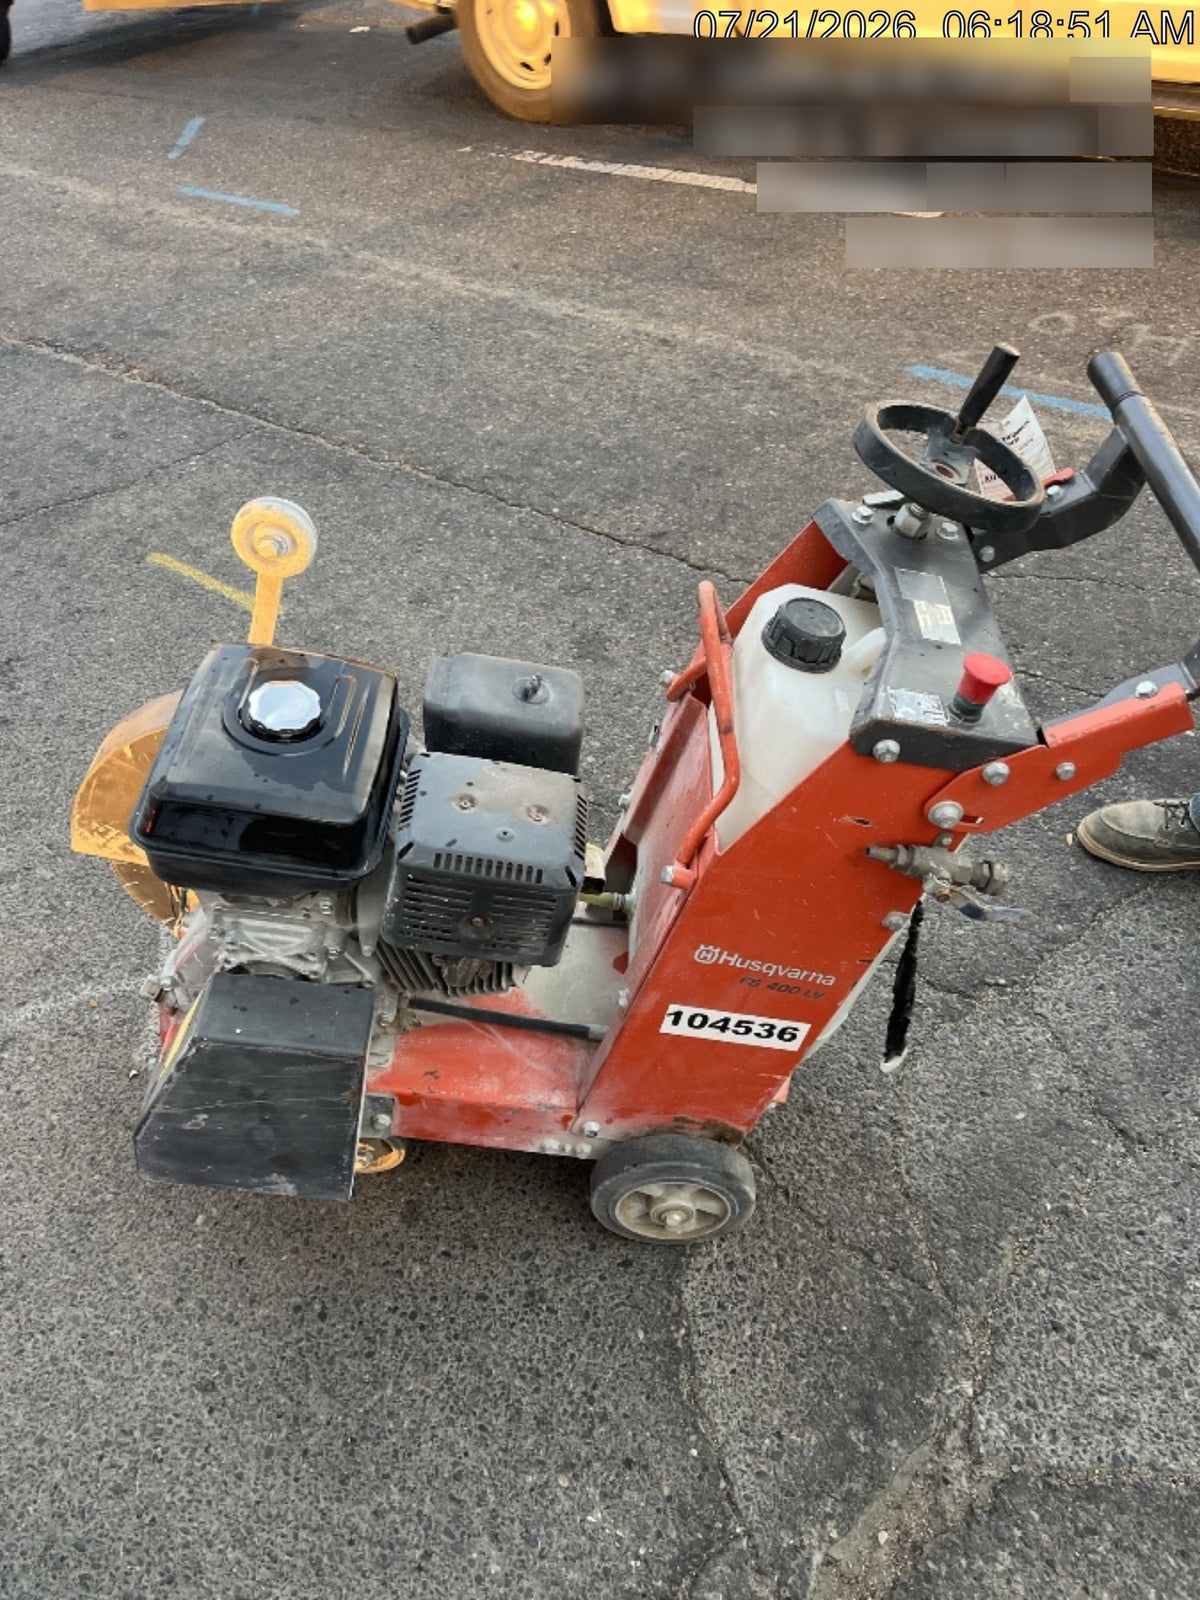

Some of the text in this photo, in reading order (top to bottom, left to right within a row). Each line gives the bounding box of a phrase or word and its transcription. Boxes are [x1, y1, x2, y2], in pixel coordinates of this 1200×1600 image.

[717, 949, 837, 987] Husqvarna
[767, 981, 802, 996] 400
[666, 1009, 801, 1043] 104536
